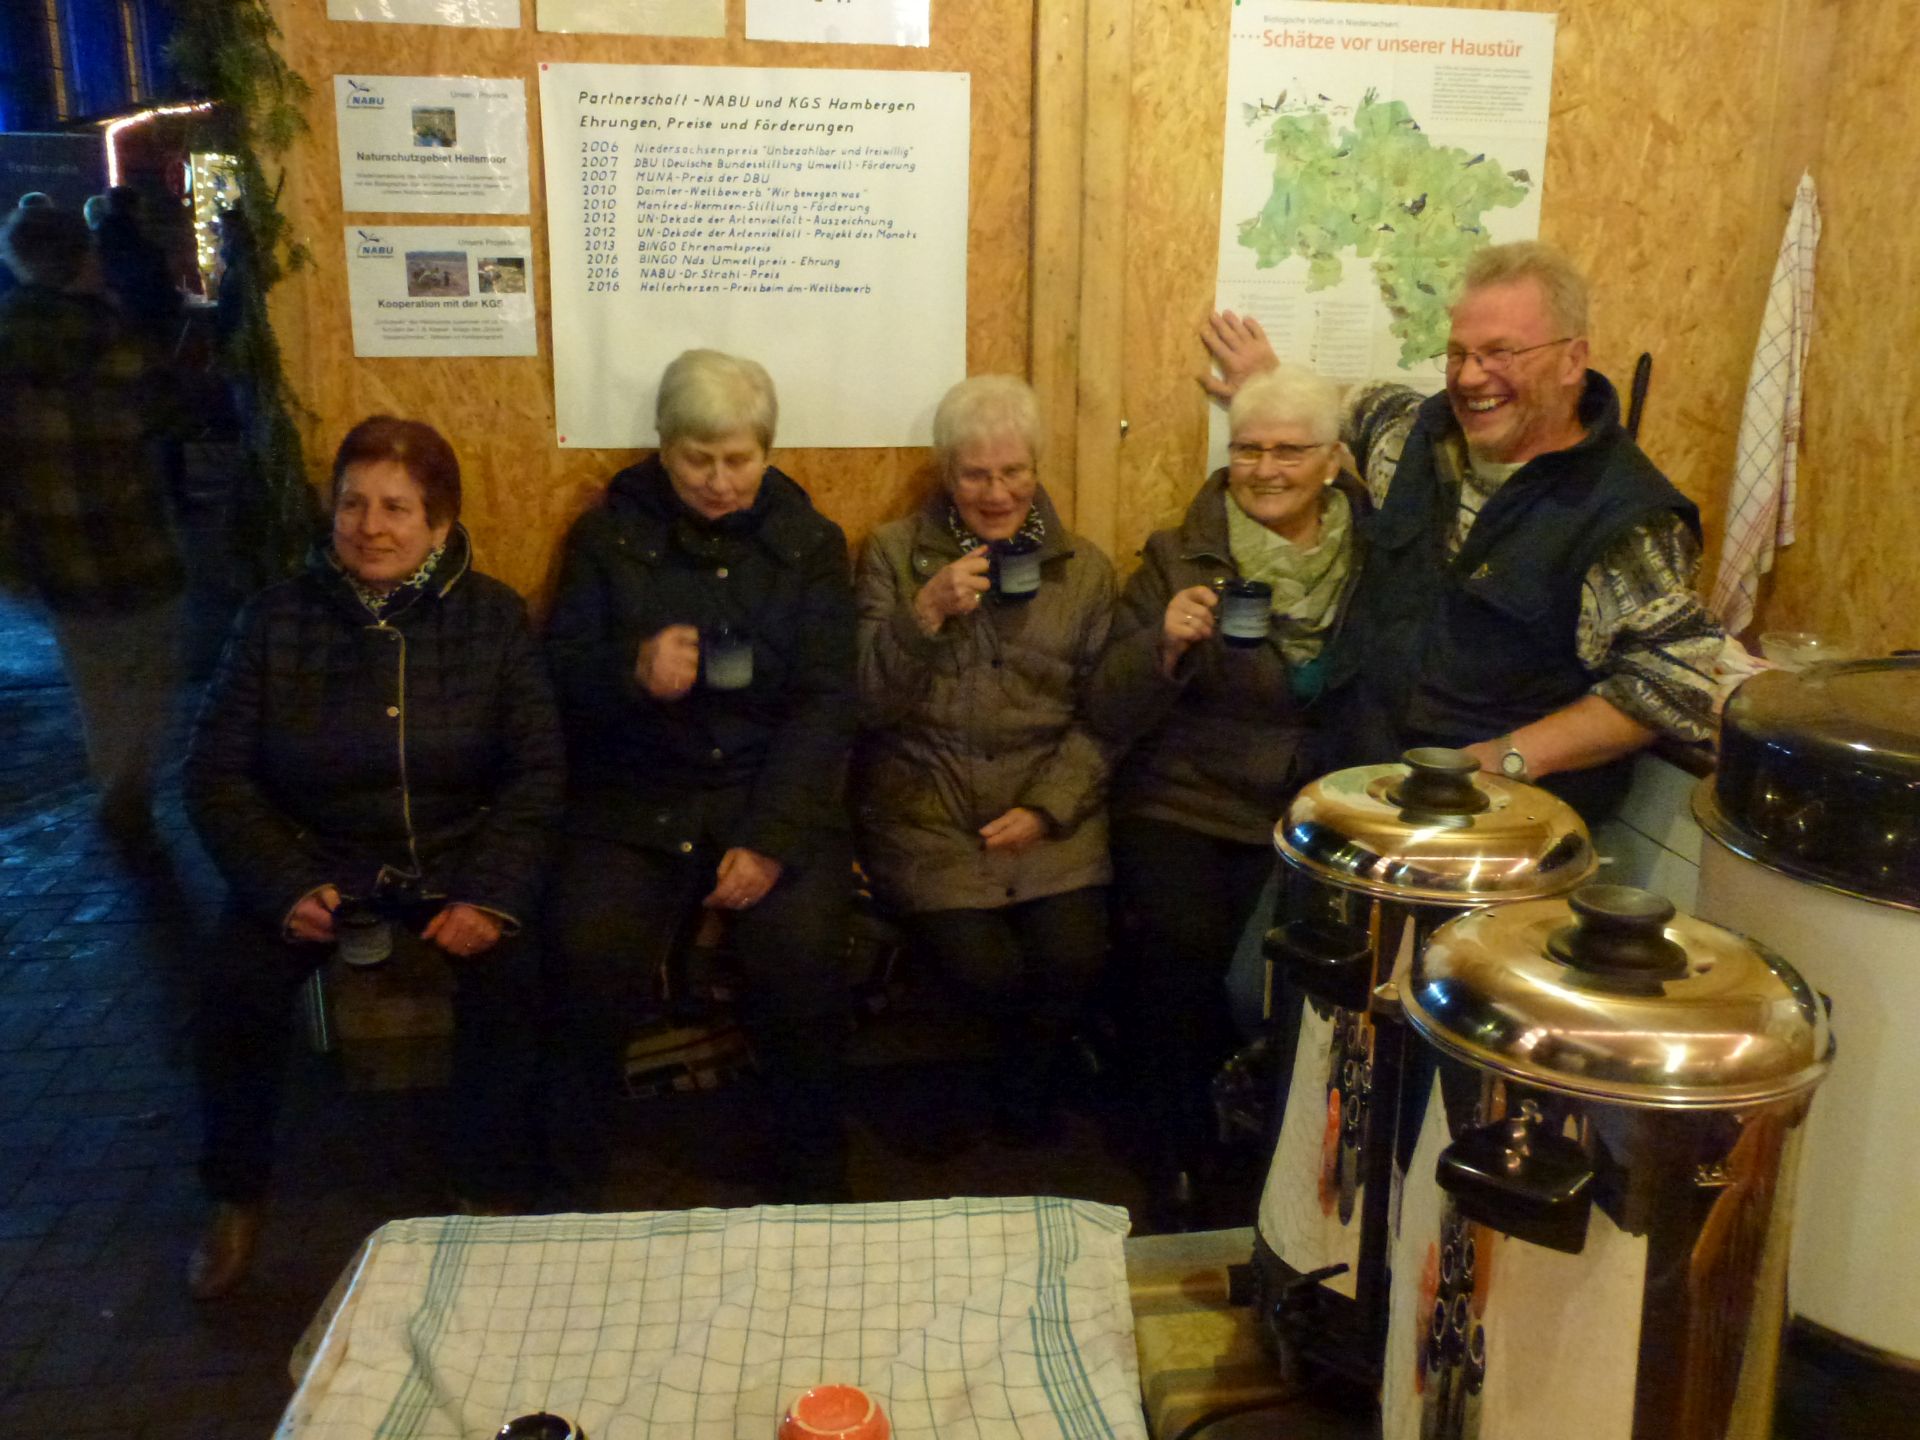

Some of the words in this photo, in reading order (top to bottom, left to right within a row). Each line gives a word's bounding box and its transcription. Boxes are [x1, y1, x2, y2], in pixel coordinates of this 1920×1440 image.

[1263, 29, 1334, 50] Schätze
[1341, 36, 1371, 51] vor
[1377, 38, 1444, 55] unserer
[1451, 38, 1523, 58] Haustür
[352, 96, 385, 106] NABU
[578, 92, 688, 105] Partnerschaft
[756, 97, 782, 108] und
[789, 97, 821, 109] KGS
[829, 98, 915, 113] Hambergen
[580, 116, 661, 130] Ehrungen,
[667, 117, 712, 129] Preise
[721, 120, 747, 130] und
[754, 119, 854, 135] Förderungen
[581, 141, 618, 152] 2006
[635, 144, 758, 157] Niedersachsenpreis
[842, 147, 861, 156] und
[356, 151, 452, 164] Naturschutzgebiet
[455, 153, 507, 164] Heilsmoor
[581, 157, 618, 168] 2007
[634, 158, 657, 168] DBU
[862, 161, 916, 172] Förderung
[582, 171, 617, 181] 2007
[718, 173, 738, 183] der
[743, 174, 770, 184] DBU
[584, 185, 616, 196] 2010
[794, 189, 837, 200] bewegen
[584, 199, 616, 210] 2010
[810, 202, 870, 214] Förderung
[584, 213, 616, 223] 2012
[708, 215, 724, 224] der
[814, 215, 893, 228] Auszeichnung
[585, 227, 616, 237] 2012
[708, 228, 725, 237] der
[814, 230, 851, 240] Projekt
[856, 230, 872, 239] des
[876, 230, 917, 239] Monats
[362, 246, 394, 255] NABU
[585, 241, 615, 251] 2013
[638, 242, 676, 251] BINGO
[588, 254, 618, 264] 2016
[640, 255, 677, 264] BINGO
[800, 257, 840, 268] Ehrung
[588, 268, 619, 278] 2016
[588, 282, 619, 292] 2016
[759, 284, 783, 293] beim
[377, 299, 440, 311] Kooperation
[443, 299, 460, 309] mit
[462, 299, 479, 309] der
